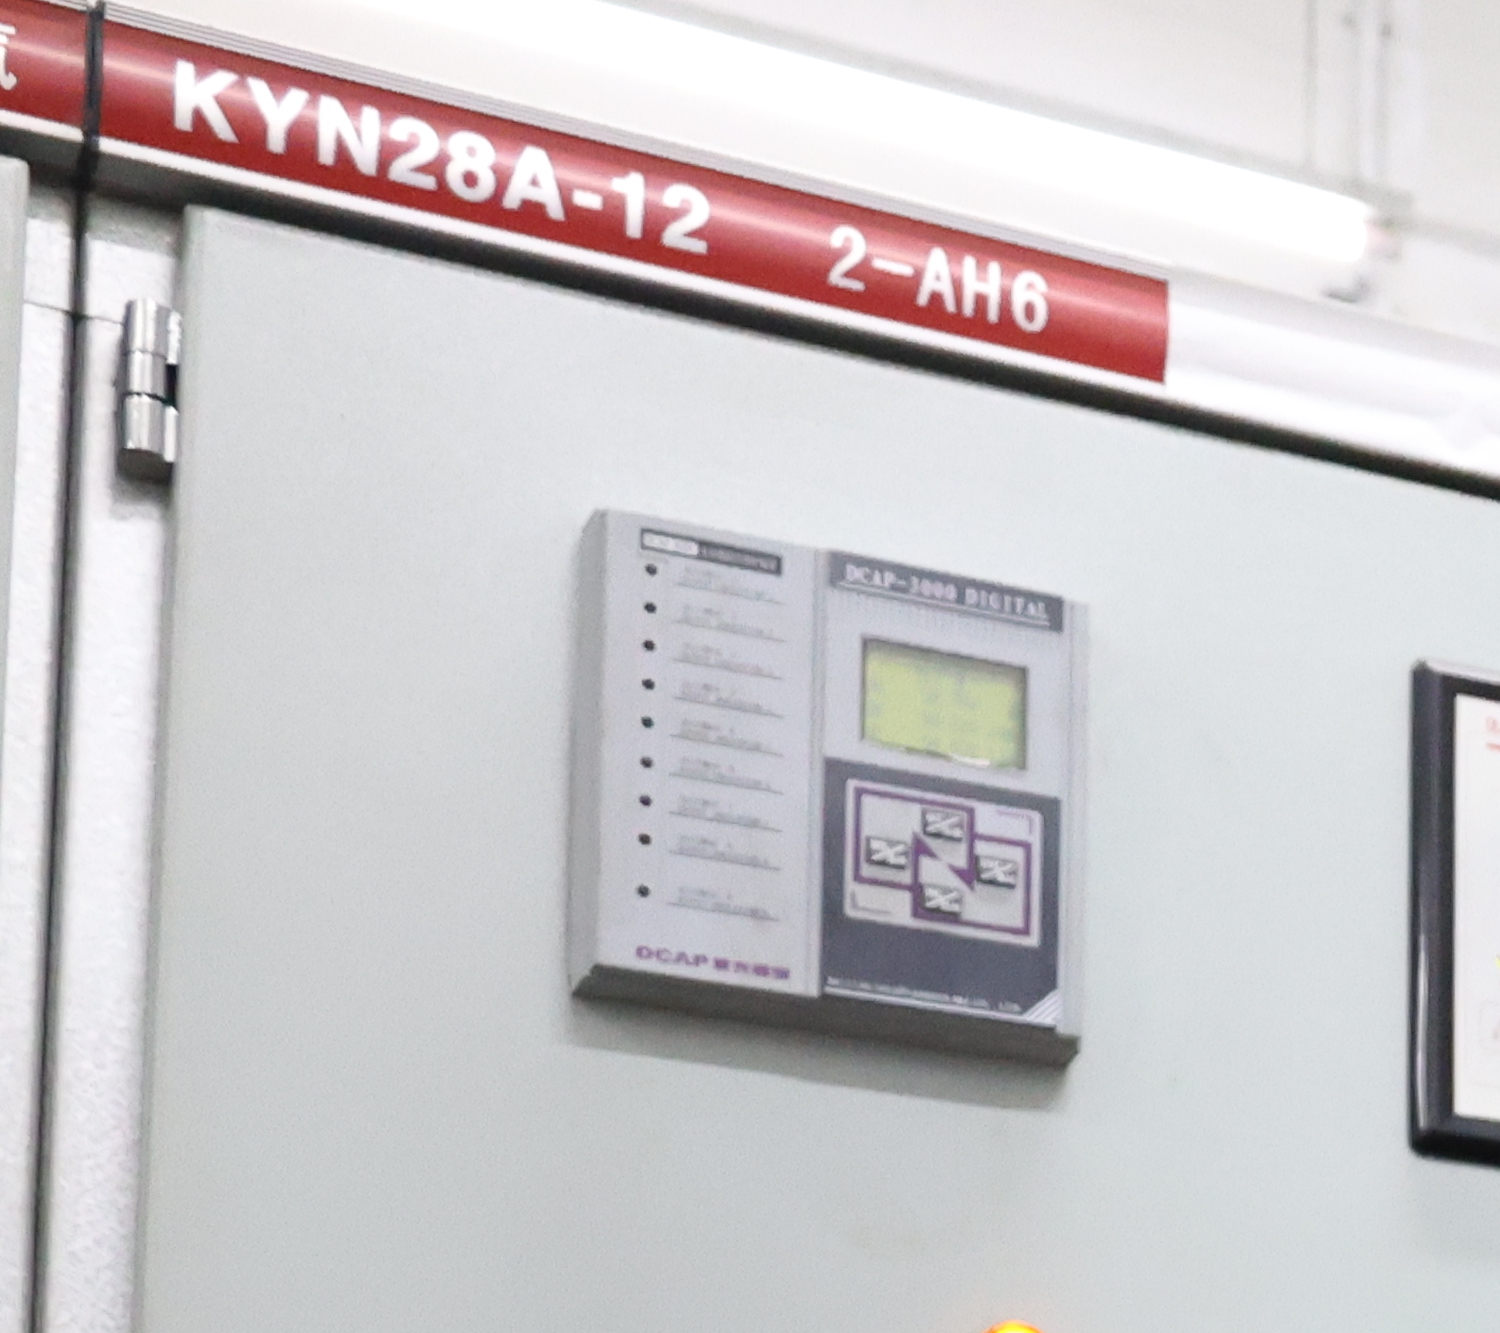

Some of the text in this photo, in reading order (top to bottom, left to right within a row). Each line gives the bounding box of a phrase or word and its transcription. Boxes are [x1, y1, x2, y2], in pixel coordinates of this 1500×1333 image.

[173, 59, 1048, 335] KYN28A-12 2-AH6
[965, 587, 1047, 618] DIGITAL
